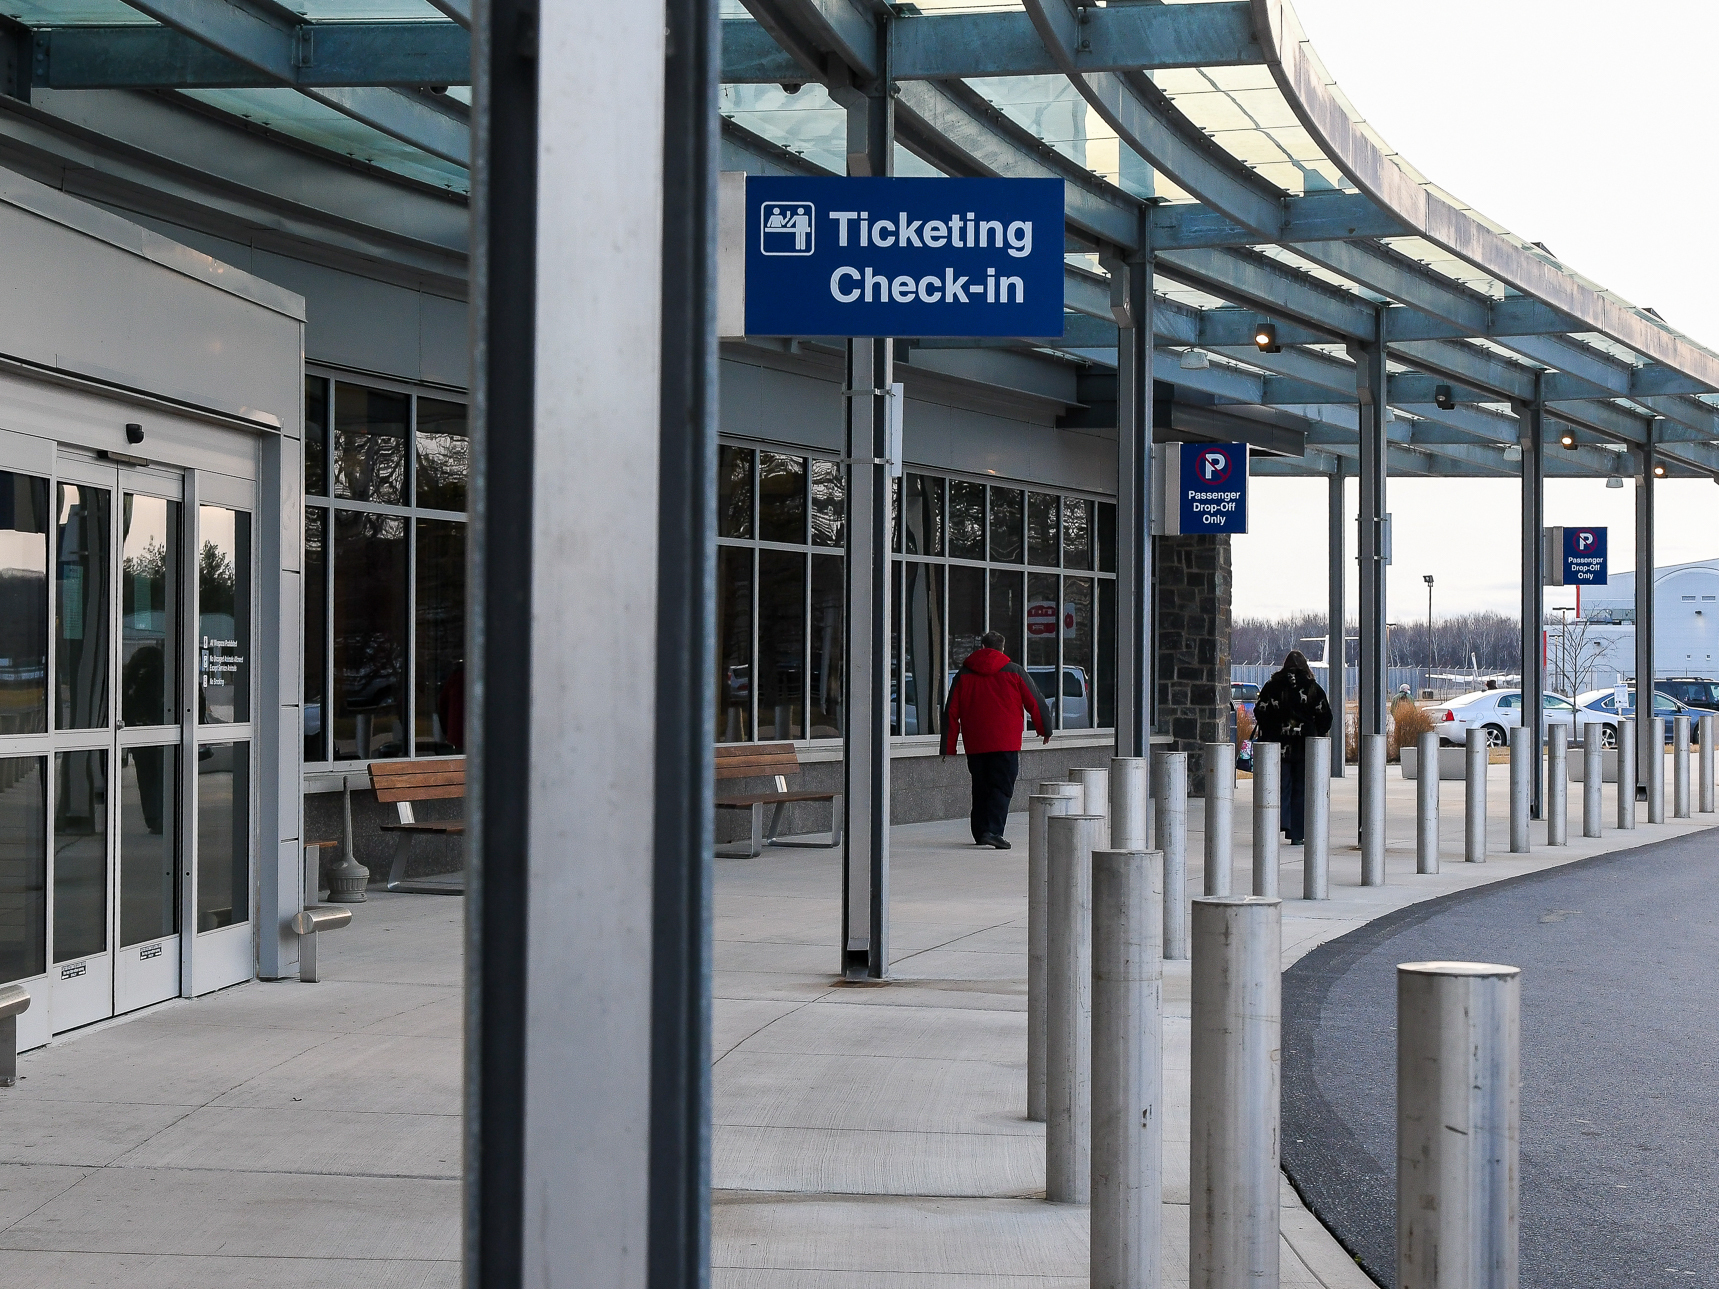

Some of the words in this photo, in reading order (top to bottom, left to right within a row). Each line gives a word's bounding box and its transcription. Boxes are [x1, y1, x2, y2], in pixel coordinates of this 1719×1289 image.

[829, 211, 1033, 258] Ticketing
[830, 266, 1024, 303] Check-in
[1188, 490, 1241, 501] Passenger
[1193, 502, 1236, 513] Drop-Off
[1202, 514, 1226, 525] Only
[1568, 556, 1603, 564] Passenger
[1571, 564, 1600, 572] Drop-Off
[1577, 572, 1594, 580] Only
